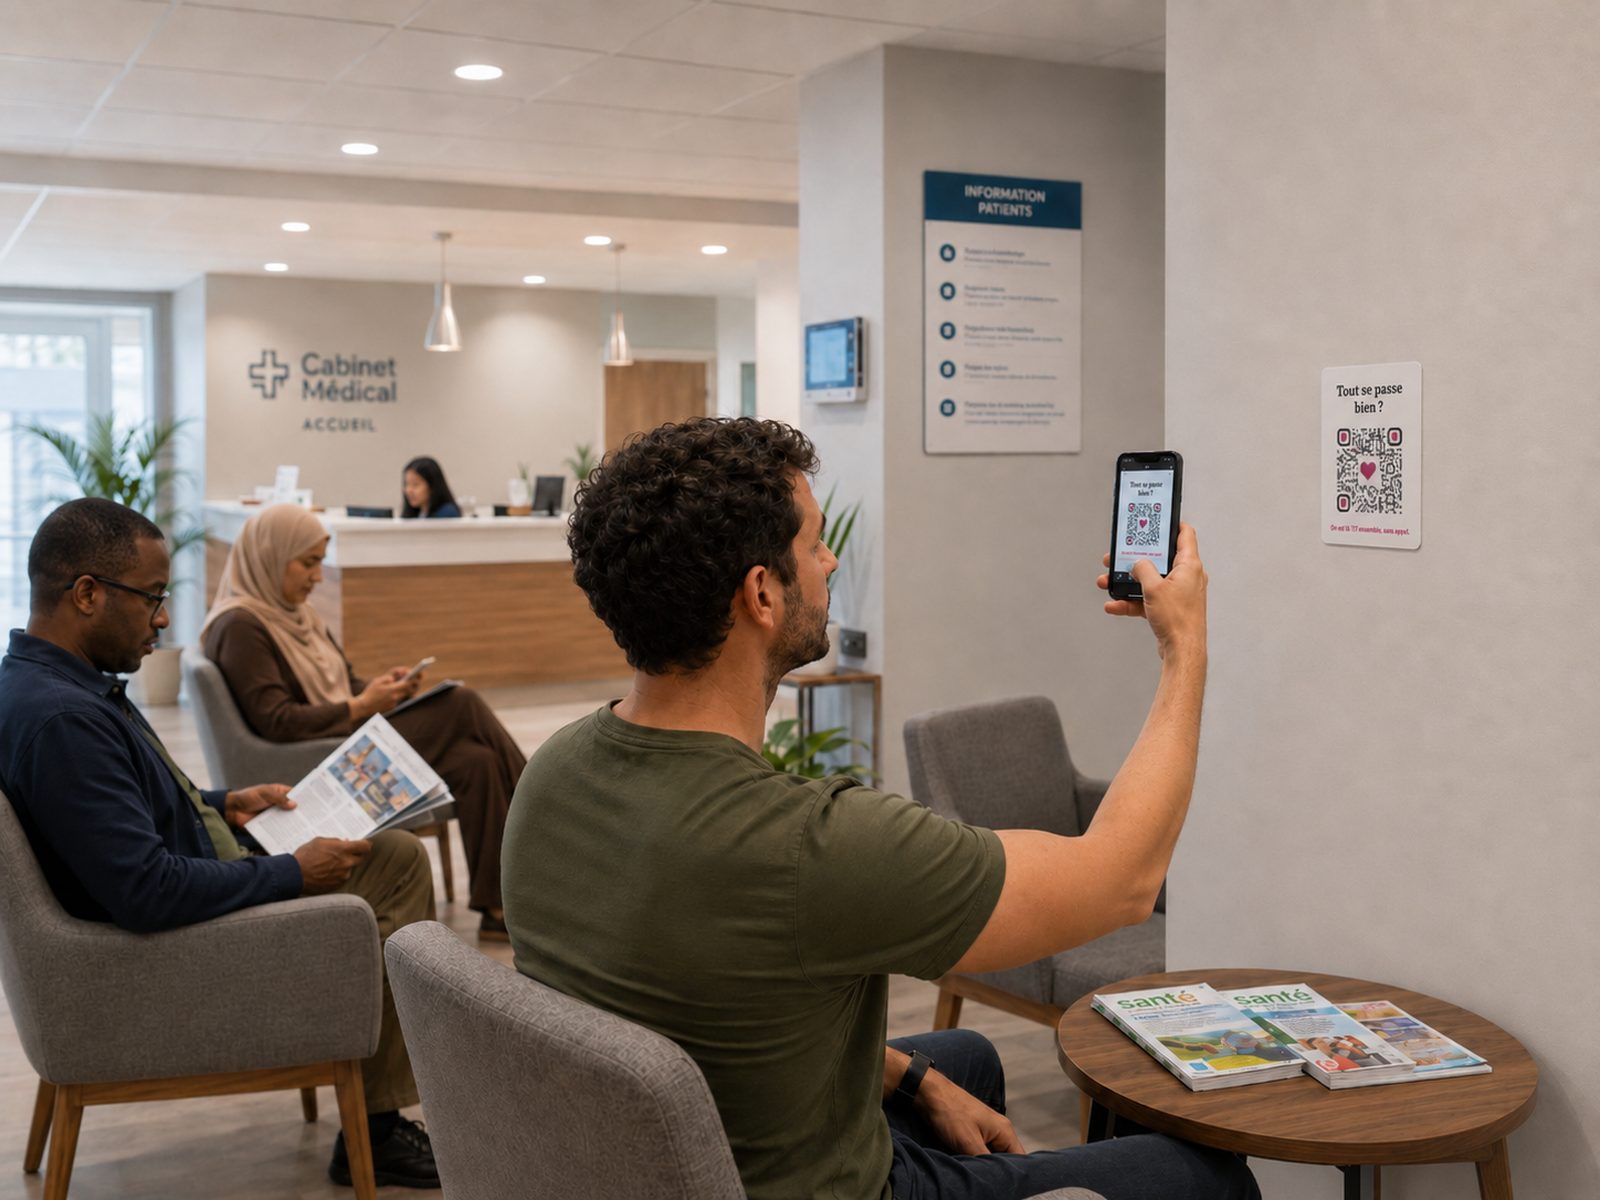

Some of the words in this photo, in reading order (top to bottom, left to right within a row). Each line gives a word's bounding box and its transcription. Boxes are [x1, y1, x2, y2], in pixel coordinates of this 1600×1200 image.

[964, 185, 1046, 203] INFORMATION
[978, 202, 1033, 218] PATIENTS
[301, 352, 396, 377] Cabinet
[302, 378, 397, 402] Médical
[1336, 384, 1359, 397] Tout
[1361, 386, 1373, 396] se
[1374, 384, 1403, 398] passe
[1354, 401, 1376, 414] bien
[1378, 400, 1384, 413] ?
[303, 417, 376, 432] ACCUEIL
[1117, 990, 1199, 1009] santé
[1233, 988, 1313, 1006] santé
